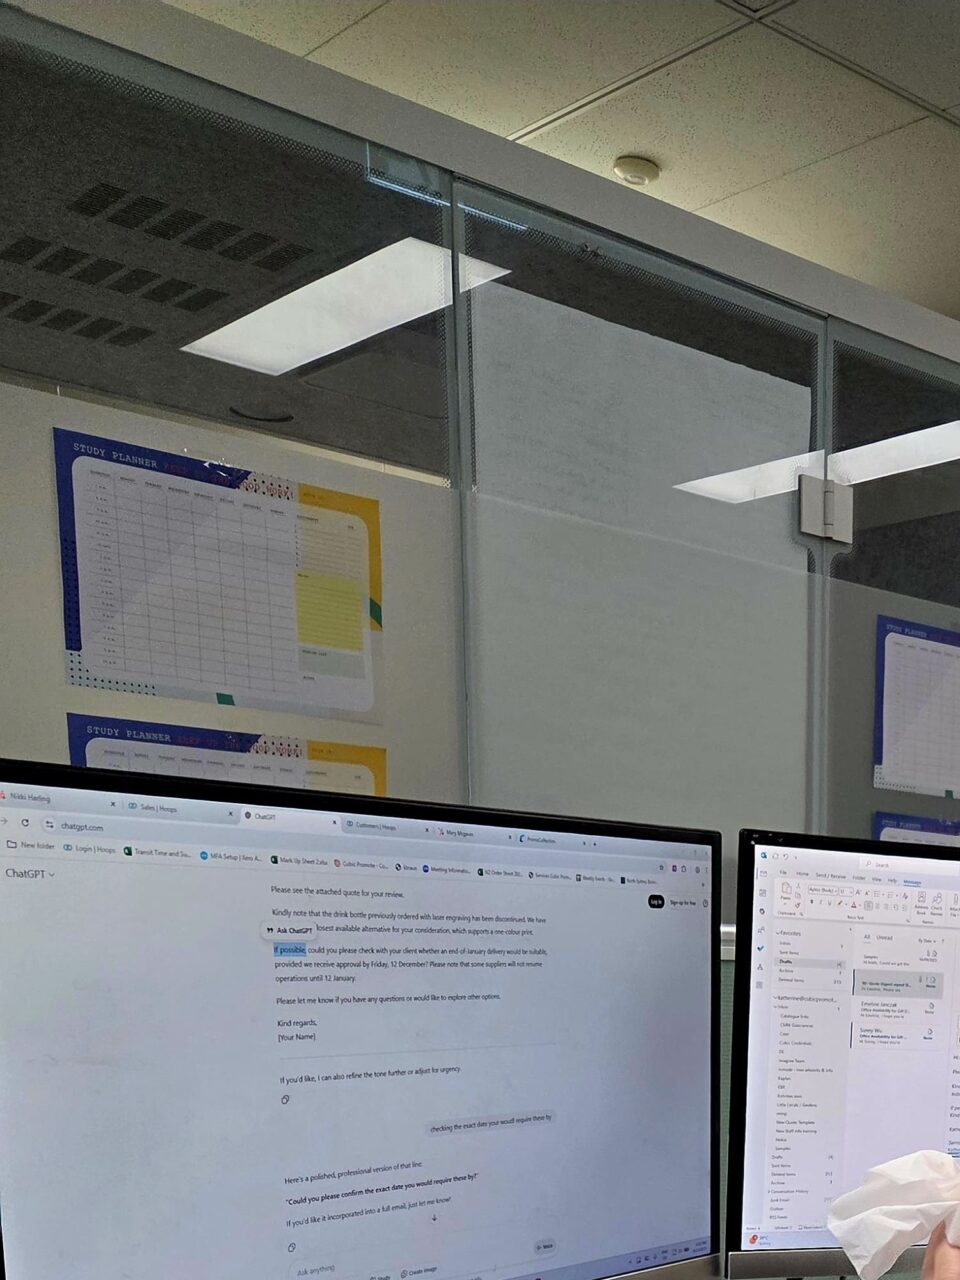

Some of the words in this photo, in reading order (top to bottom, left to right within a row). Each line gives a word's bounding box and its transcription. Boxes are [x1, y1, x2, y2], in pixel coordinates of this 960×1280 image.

[73, 442, 106, 457] STUDY
[112, 451, 158, 469] PLANNER
[86, 725, 120, 737] STUDY
[126, 729, 172, 743] PLANNER
[61, 822, 104, 832] chatgpt.com
[36, 842, 55, 850] folder
[75, 844, 92, 853] Login
[5, 869, 46, 880] ChatGPT
[271, 885, 290, 894] Please
[305, 887, 314, 895] the
[316, 887, 340, 896] attached
[343, 888, 360, 899] quote
[361, 889, 370, 897] for
[370, 891, 384, 900] your
[272, 908, 291, 919] Kindly
[293, 909, 307, 917] note
[308, 909, 320, 918] that
[322, 910, 332, 918] the
[333, 910, 348, 918] drink
[350, 910, 366, 919] bottle
[368, 911, 396, 922] previously
[397, 912, 419, 921] ordered
[420, 913, 431, 921] with
[446, 914, 470, 924] engraving
[472, 914, 481, 922] has
[482, 914, 494, 923] been
[527, 916, 535, 924] We
[536, 916, 546, 924] have
[335, 924, 360, 932] available
[362, 924, 391, 933] alternative
[392, 925, 400, 933] for
[401, 927, 413, 935] your
[452, 926, 466, 934] which
[468, 926, 489, 937] supports
[308, 945, 325, 954] could
[326, 947, 337, 956] you
[339, 946, 357, 956] please
[359, 946, 374, 954] check
[376, 946, 388, 954] with
[389, 948, 402, 956] your
[403, 946, 417, 954] client
[419, 946, 439, 954] whether
[487, 946, 505, 957] delivery
[507, 947, 521, 955] would
[522, 947, 528, 955] be
[275, 960, 302, 970] provided
[336, 960, 361, 970] approval
[363, 960, 370, 970] by
[391, 960, 397, 968] 12
[430, 960, 446, 968] Please
[447, 960, 458, 968] note
[460, 960, 470, 968] that
[508, 960, 516, 968] will
[517, 960, 525, 968] not
[275, 974, 308, 984] operations
[310, 974, 323, 982] until
[325, 974, 332, 982] 12
[276, 996, 296, 1005] Please
[318, 995, 333, 1004] know
[335, 995, 340, 1003] if
[341, 997, 351, 1005] you
[353, 995, 366, 1003] have
[367, 996, 378, 1005] any
[379, 994, 405, 1004] questions
[413, 993, 429, 1002] would
[431, 993, 440, 1001] like
[441, 993, 447, 1001] to
[448, 992, 466, 1003] explore
[467, 992, 480, 1000] other
[277, 1018, 292, 1027] Kind
[297, 1268, 309, 1277] Ask
[310, 1264, 336, 1276] anything
